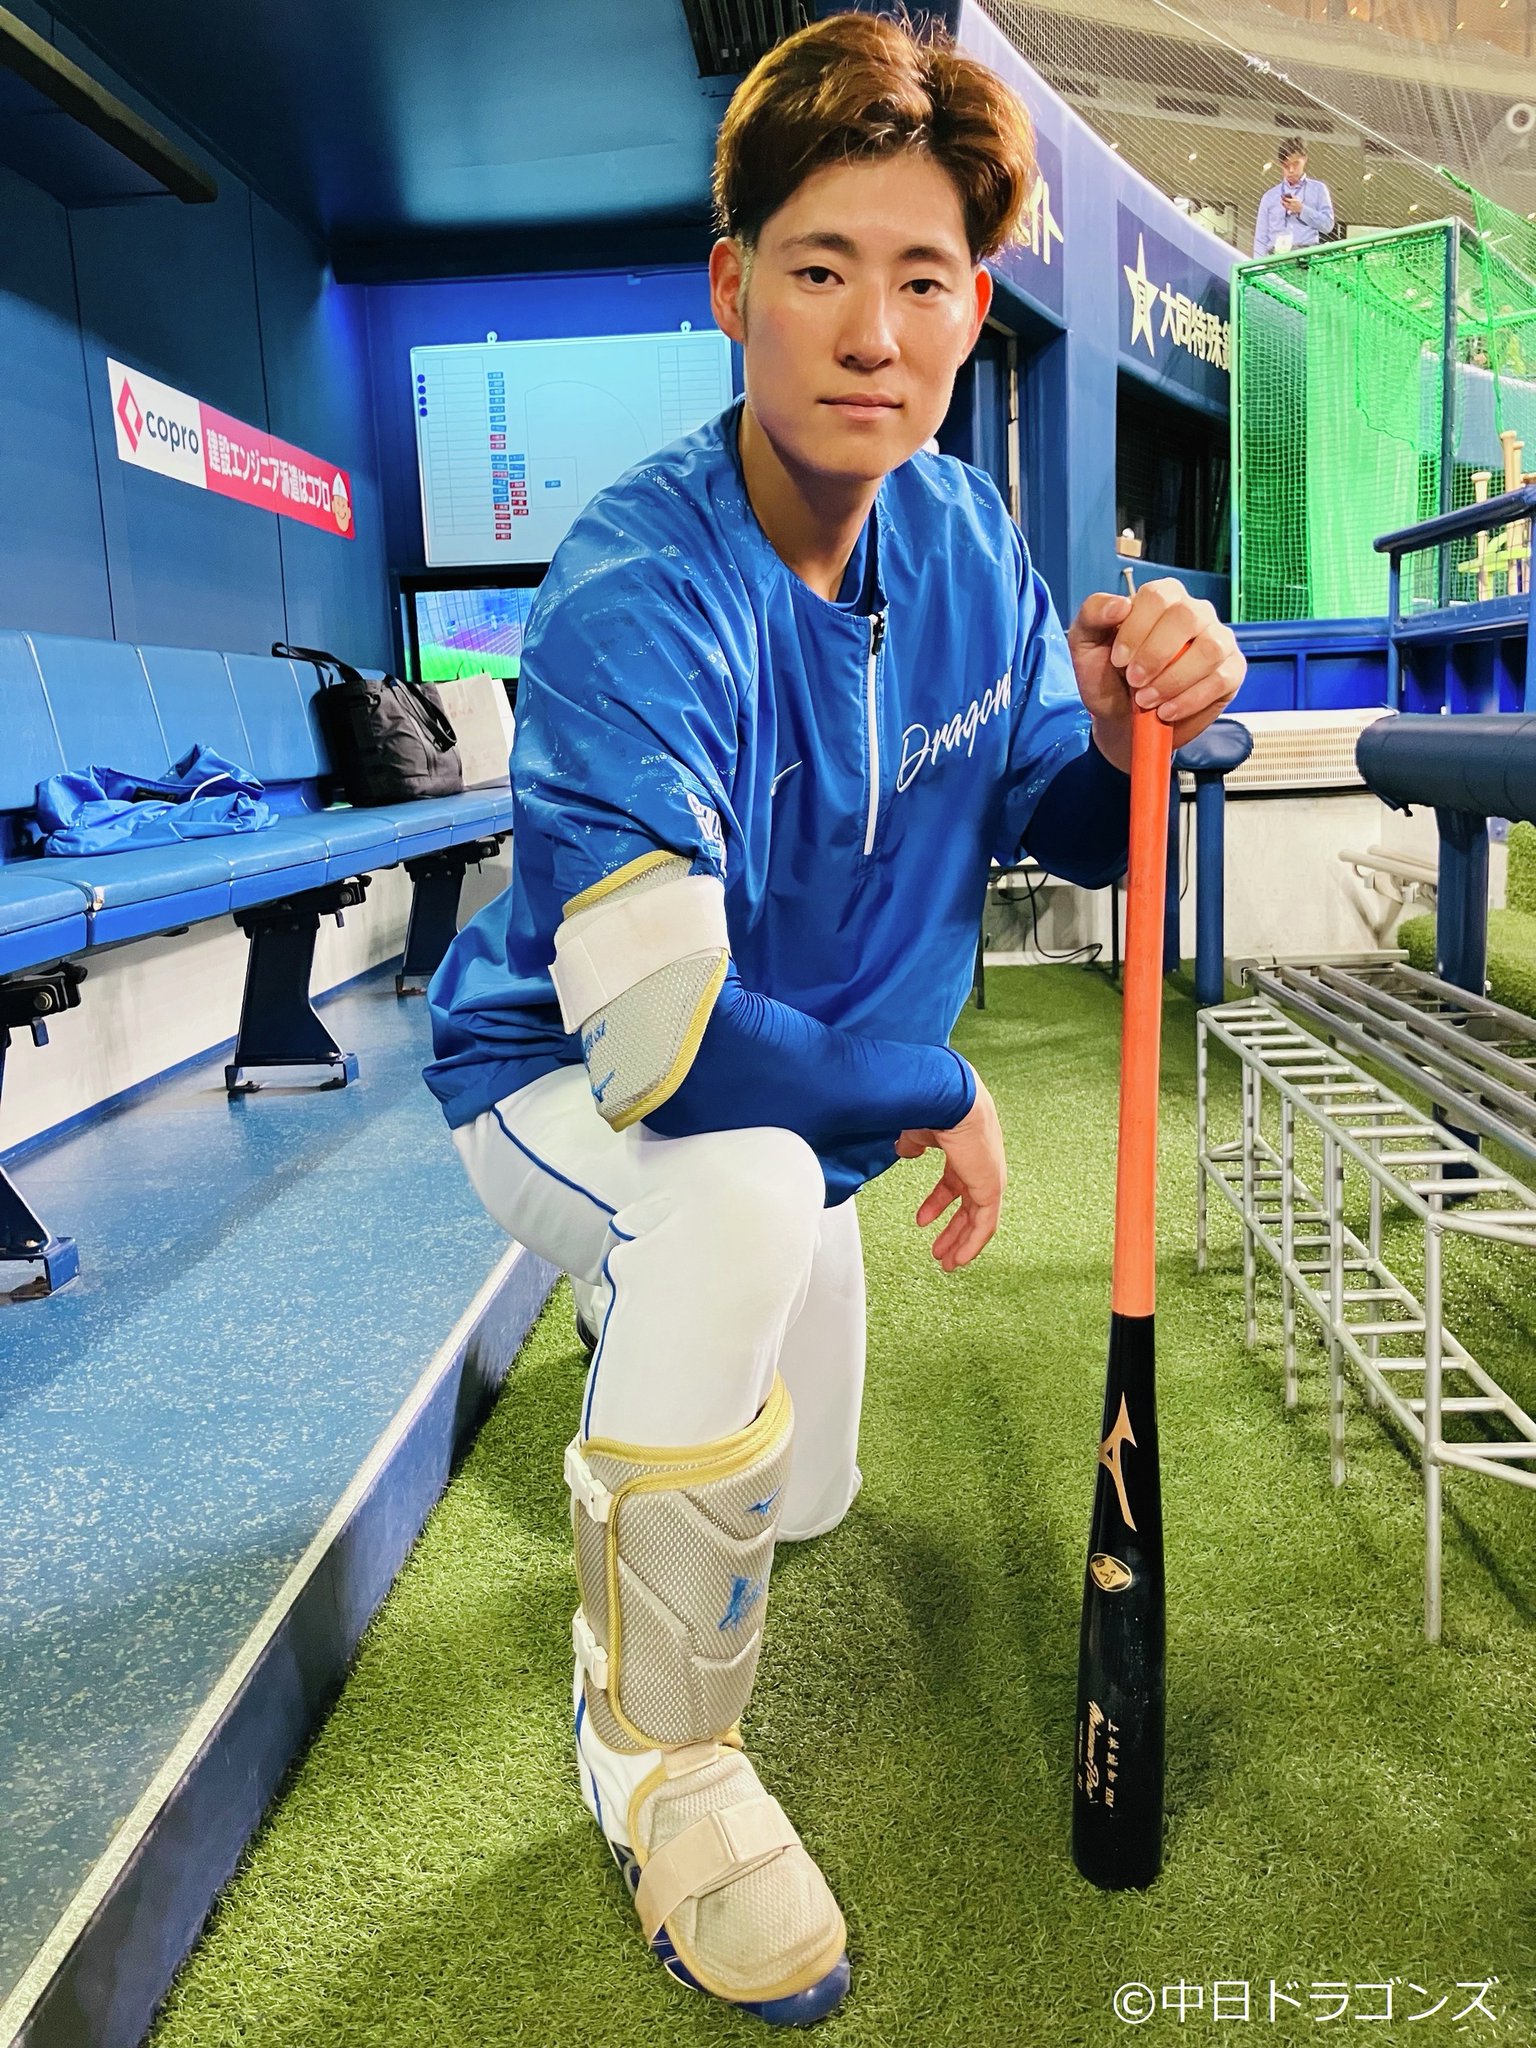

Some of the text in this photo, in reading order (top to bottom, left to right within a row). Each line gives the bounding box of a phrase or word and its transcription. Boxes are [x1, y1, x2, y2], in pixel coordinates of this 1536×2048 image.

[145, 410, 199, 455] copro
[206, 428, 331, 513] 建設エンジニア派遣はコプロ
[896, 664, 1013, 793] Dragon
